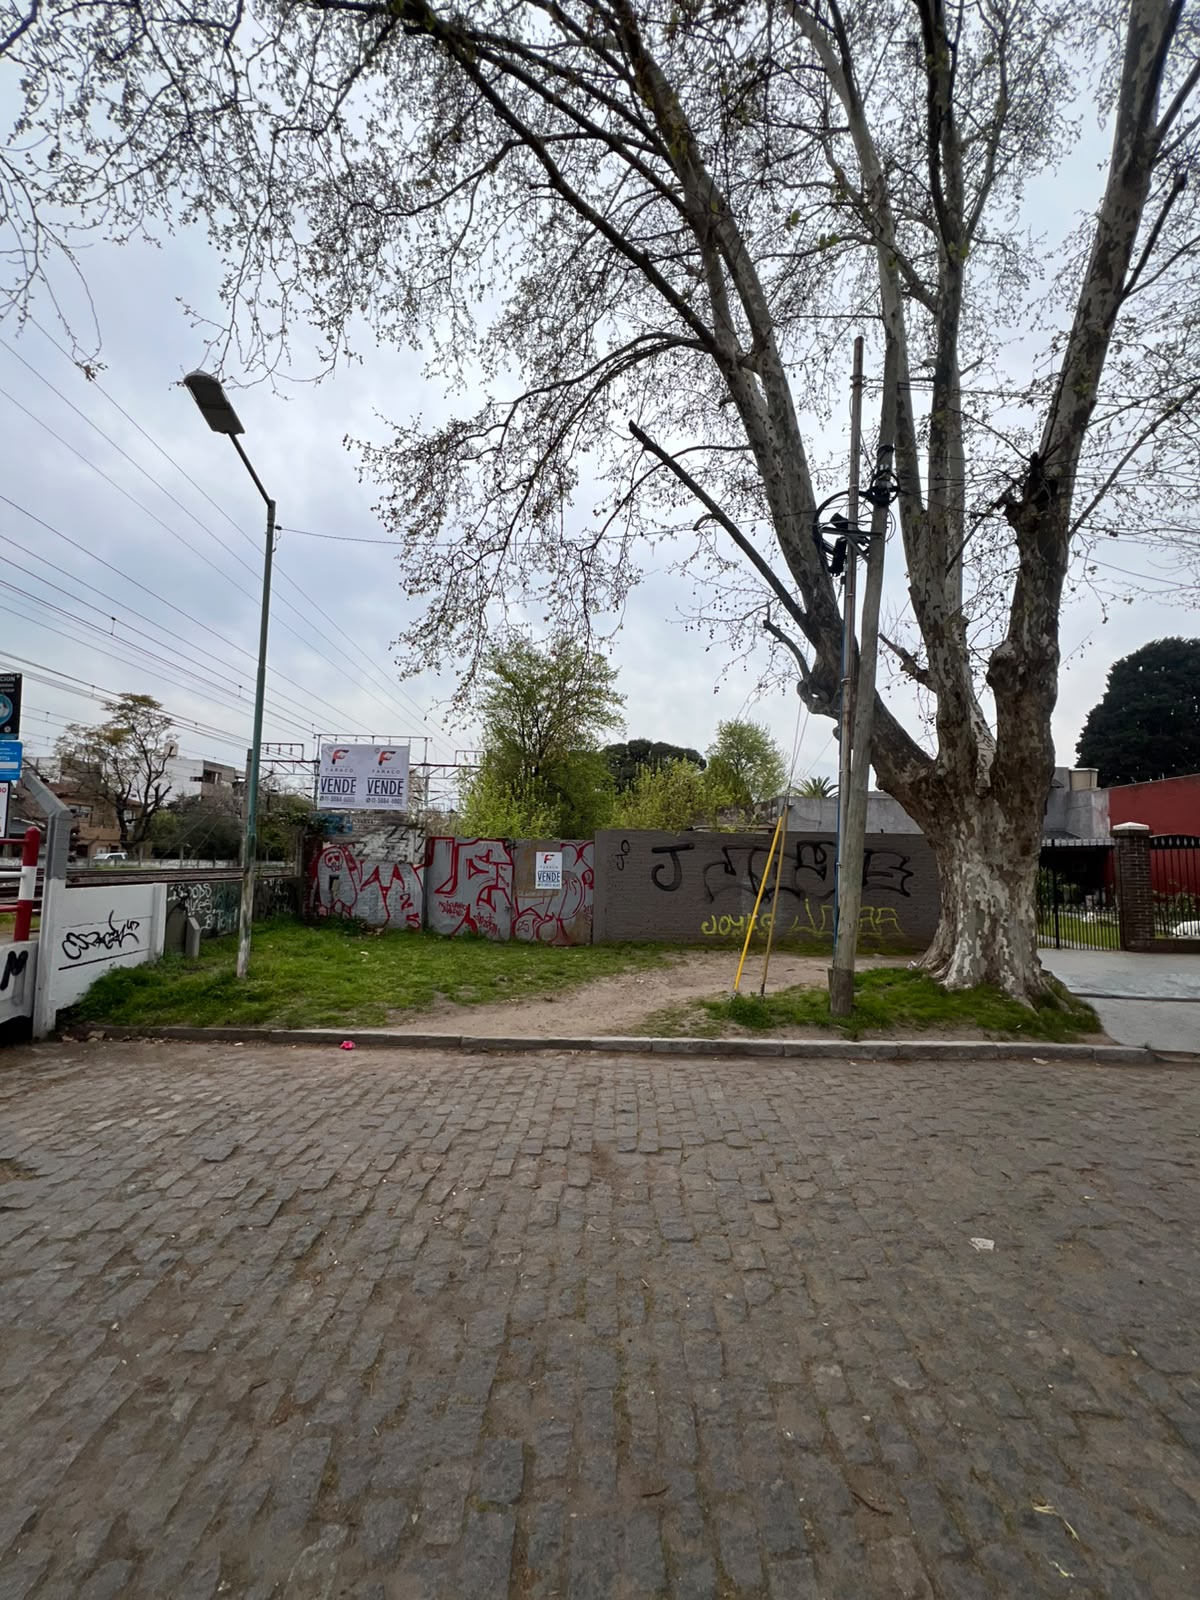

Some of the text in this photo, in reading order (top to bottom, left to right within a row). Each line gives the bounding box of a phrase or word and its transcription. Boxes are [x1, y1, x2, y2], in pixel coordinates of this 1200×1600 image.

[320, 778, 357, 794] VENDE
[367, 779, 404, 795] VENDE
[537, 872, 560, 882] VENDE
